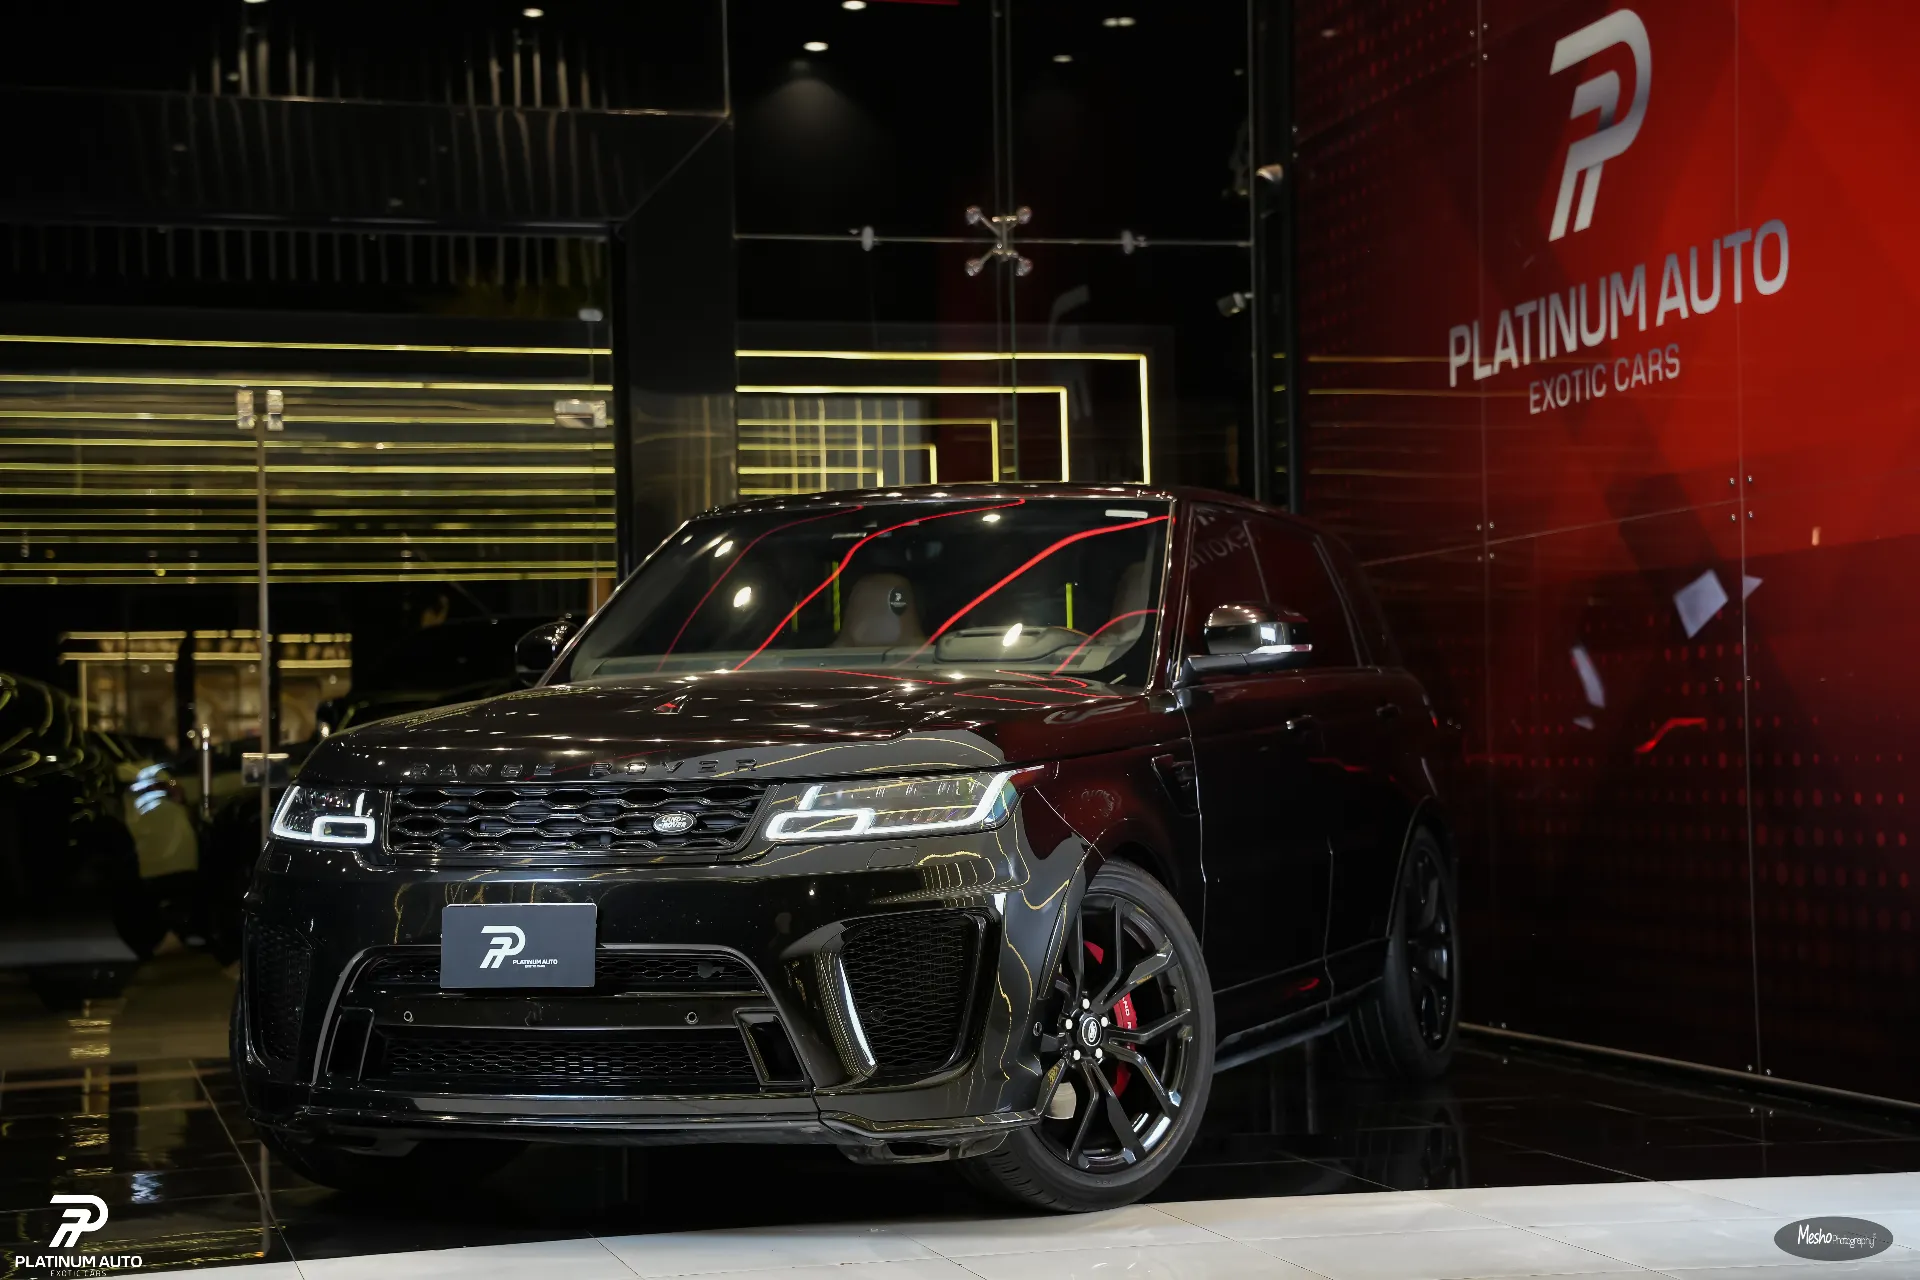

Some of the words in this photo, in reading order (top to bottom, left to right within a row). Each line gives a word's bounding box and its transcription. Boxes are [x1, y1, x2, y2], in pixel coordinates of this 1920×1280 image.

[1449, 263, 1647, 388] PLATINUM
[1655, 218, 1790, 327] AUTO
[1529, 364, 1607, 415] EXOTIC
[1613, 342, 1681, 393] CARS
[409, 762, 556, 779] RANGE
[588, 758, 757, 777] ROVER
